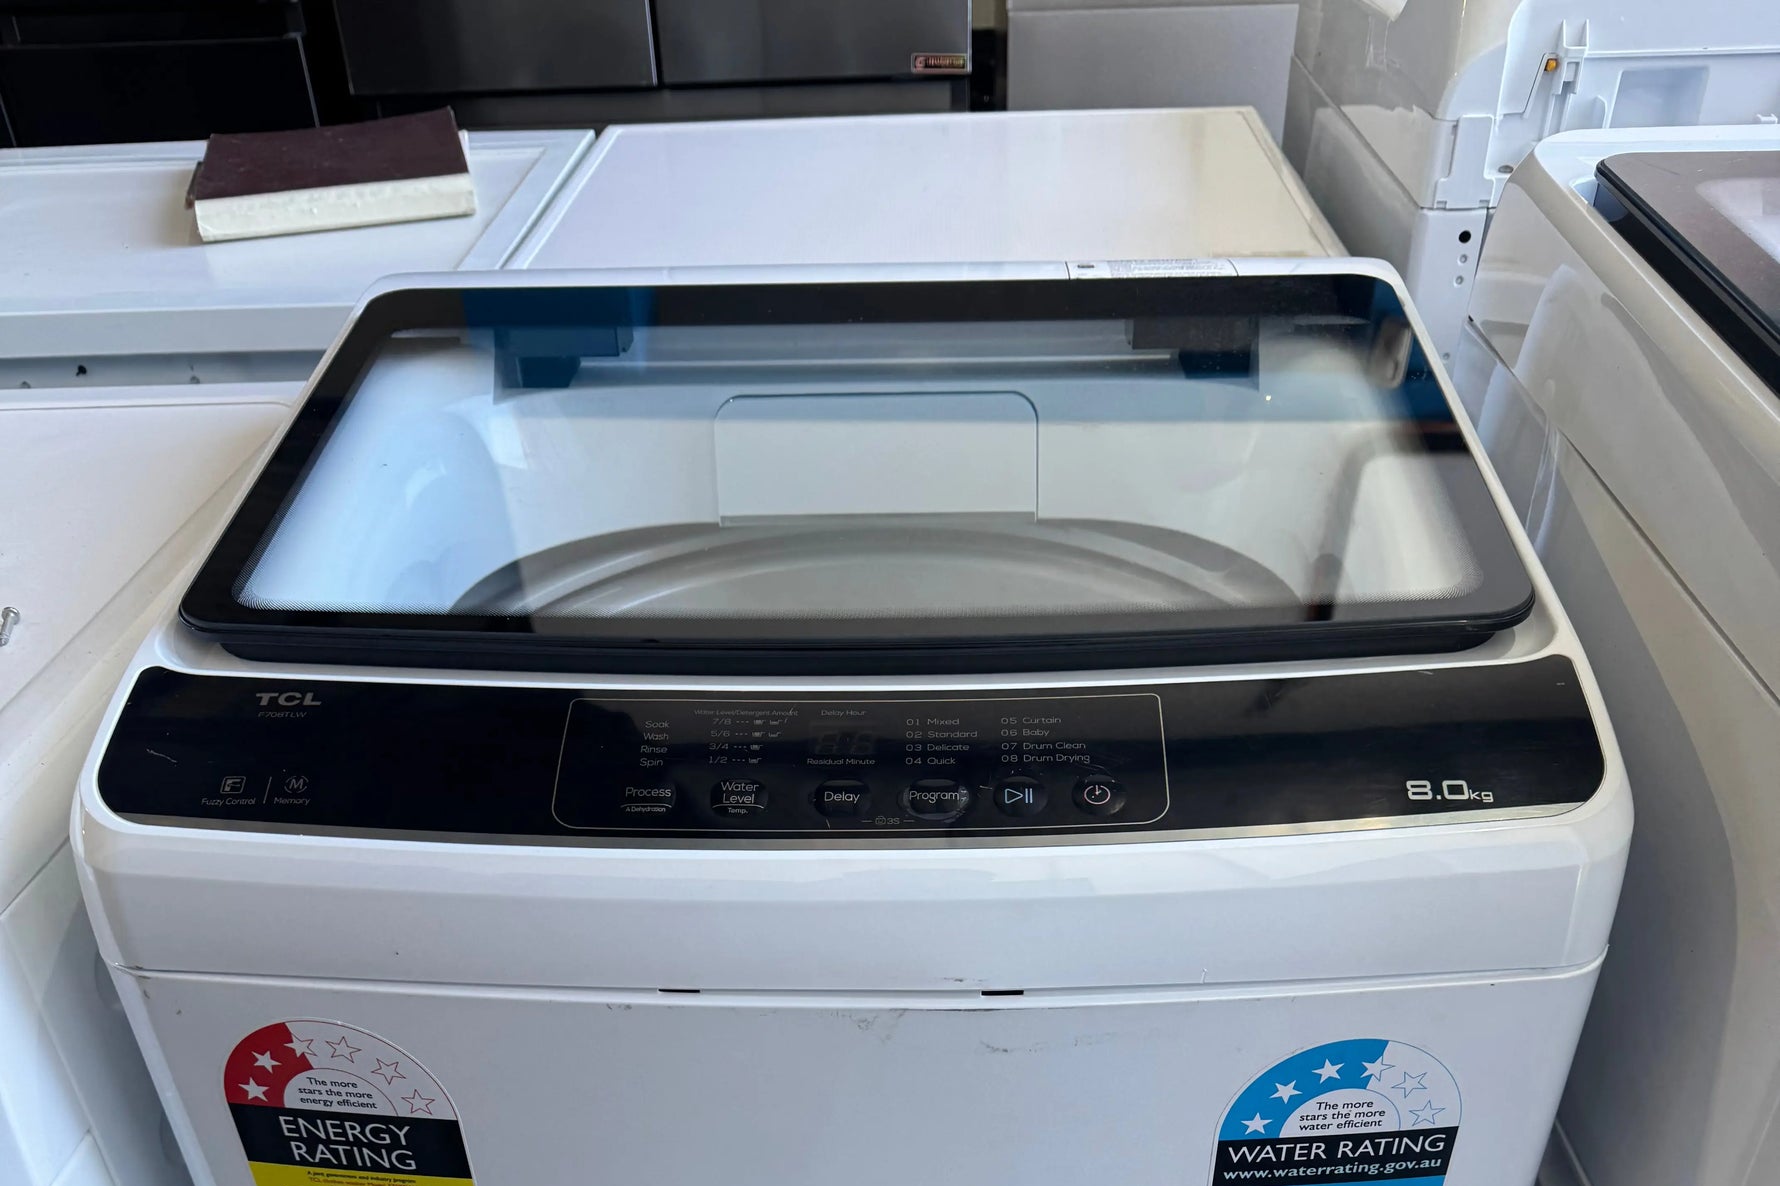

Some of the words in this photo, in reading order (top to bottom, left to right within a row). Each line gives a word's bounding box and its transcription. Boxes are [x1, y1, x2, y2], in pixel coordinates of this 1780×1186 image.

[256, 692, 322, 706] TCL
[821, 709, 844, 717] Delay
[645, 720, 670, 729] Soak
[906, 718, 919, 726] 01
[927, 717, 960, 726] Mixed
[1000, 717, 1017, 725] 05
[1022, 716, 1062, 725] Curtain
[642, 732, 669, 741] Wash
[710, 730, 731, 738] 5/6
[927, 730, 978, 739] Standard
[1022, 728, 1051, 737] Baby
[640, 745, 668, 754] Rinse
[709, 742, 729, 750] 3/4
[905, 743, 923, 752] 03
[927, 743, 970, 752] Delicate
[1001, 742, 1018, 750] 07
[1023, 742, 1053, 750] Drum
[1055, 741, 1087, 750] Clean
[639, 758, 664, 768] Spin
[708, 756, 728, 764] 1/2
[807, 757, 844, 766] Residual
[845, 757, 876, 765] Minute
[905, 757, 922, 765] 04
[927, 757, 957, 765] Quick
[1001, 754, 1019, 763] 08
[1023, 754, 1053, 762] Drum
[1056, 753, 1091, 764] Drying
[721, 781, 760, 792] Water
[625, 787, 672, 798] Process
[824, 791, 861, 804] Delay
[909, 790, 960, 803] Program
[200, 797, 225, 807] Fuzzy
[225, 796, 257, 806] Control
[273, 797, 311, 806] Memory
[723, 793, 755, 804] Level
[728, 807, 749, 815] Temp.
[306, 1077, 328, 1087] The
[330, 1080, 358, 1089] more
[298, 1086, 323, 1096] stars
[325, 1087, 343, 1097] the
[345, 1091, 374, 1100] more
[300, 1097, 334, 1108] energy
[337, 1098, 378, 1110] efficient
[1315, 1101, 1340, 1111] The
[1342, 1101, 1374, 1110] more
[1299, 1113, 1328, 1122] stars
[1331, 1110, 1352, 1120] the
[1354, 1109, 1386, 1118] more
[1299, 1121, 1333, 1131] water
[1336, 1118, 1383, 1129] efficient
[278, 1115, 411, 1146] ENERGY
[1228, 1141, 1327, 1164] WATER
[1337, 1134, 1447, 1159] RATING
[290, 1141, 417, 1171] RATING
[1223, 1158, 1443, 1180] www.waterrating.gov.au
